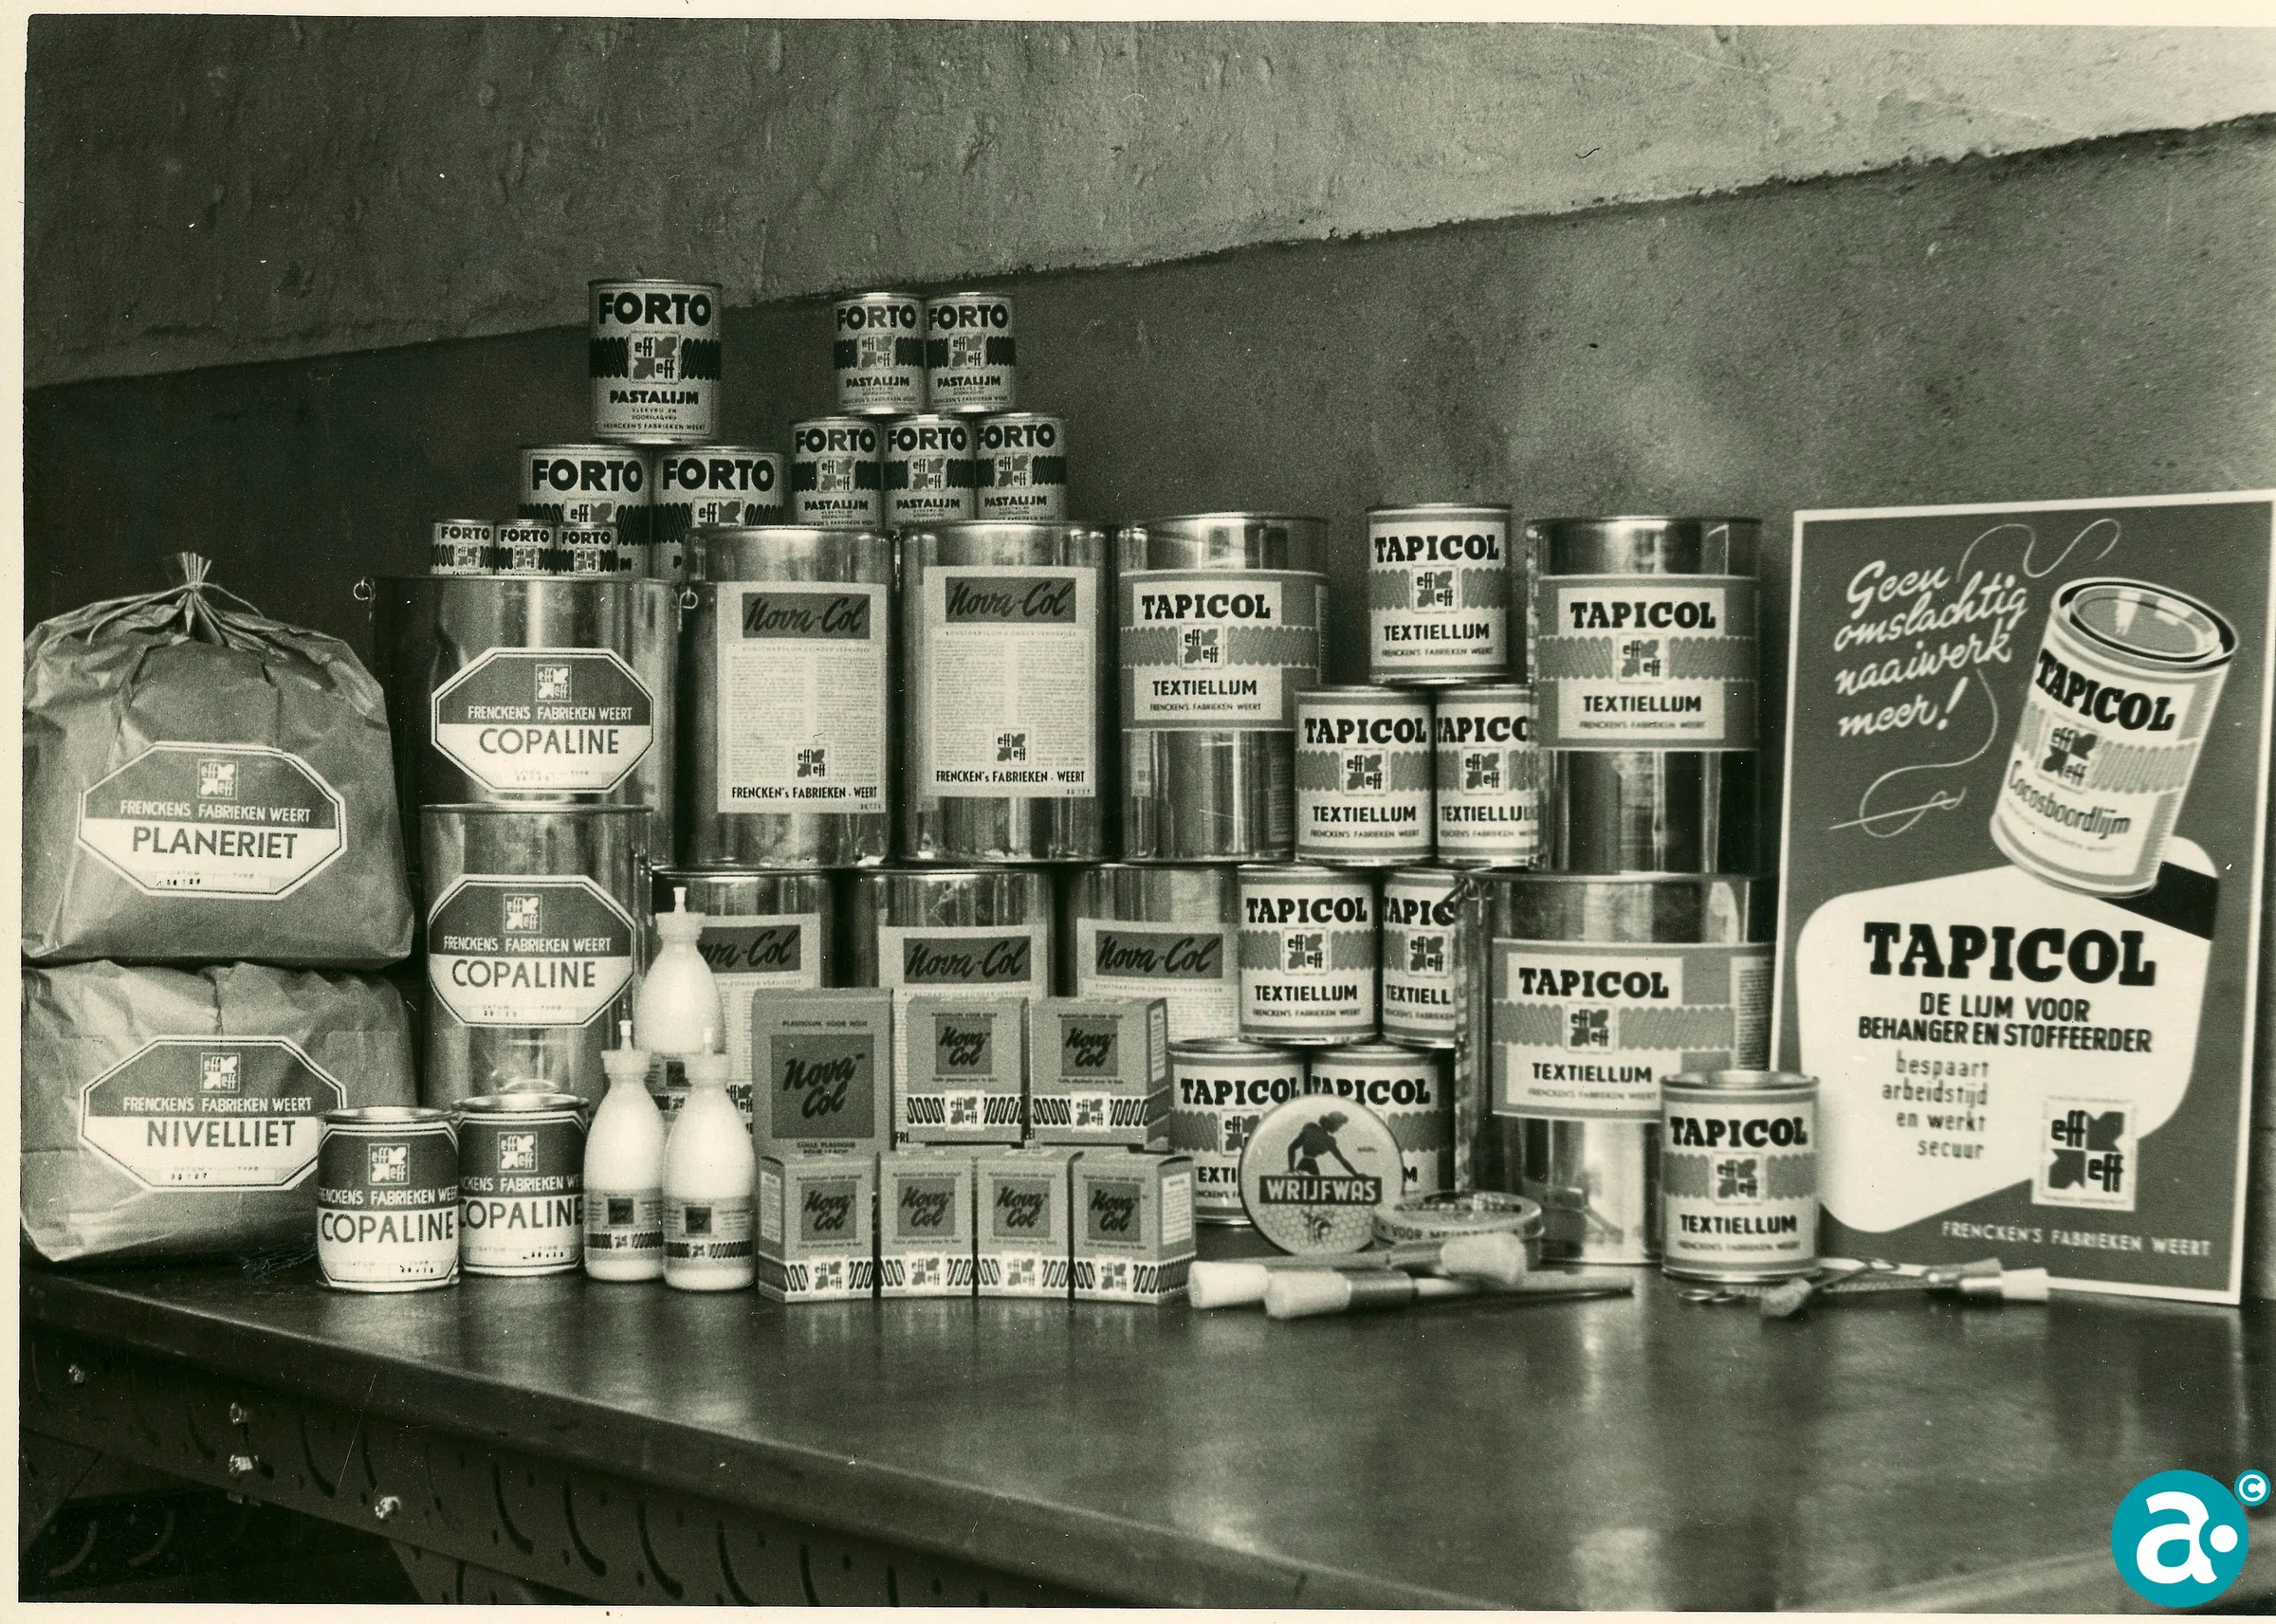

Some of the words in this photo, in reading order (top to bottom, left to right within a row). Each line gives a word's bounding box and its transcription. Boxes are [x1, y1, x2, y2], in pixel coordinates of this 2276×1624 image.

[599, 292, 711, 326] FORTO
[837, 305, 916, 331] FORTO
[928, 304, 1009, 330] FORTO
[635, 337, 652, 356] eff
[656, 359, 674, 378] eff
[846, 376, 909, 388] PASTALIJM
[938, 375, 1000, 387] PASTALIJM
[610, 391, 698, 404] PASTALIJM
[796, 429, 875, 453] FORTO
[888, 428, 967, 452] FORTO
[977, 424, 1055, 450] FORTO
[532, 459, 643, 492] FORTO
[663, 458, 774, 491] FORTO
[441, 526, 489, 540] FORTO
[501, 529, 549, 542] FORTO
[562, 532, 612, 544] FORTO
[1375, 535, 1498, 563] TAPICOL
[1417, 573, 1433, 589] eff
[1847, 560, 1949, 619] Geen
[1142, 594, 1271, 620] TAPICOL
[1436, 590, 1453, 606] eff
[1570, 602, 1716, 629] TAPICOL
[1834, 570, 2028, 651] omslachtig
[1835, 618, 2011, 695] naaiwerk
[2035, 648, 2175, 731] TAPICOL
[538, 706, 595, 720] FABRIEKEN
[599, 707, 633, 721] WEERT
[1839, 677, 1969, 737] meer!
[480, 728, 618, 754] COPALINE
[998, 734, 1010, 746] eff
[1305, 718, 1426, 743] TAPICOL
[1438, 716, 1528, 743] TAPICO
[798, 749, 811, 762] eff
[1013, 747, 1026, 760] eff
[813, 763, 825, 776] eff
[993, 771, 1048, 782] FABRIEKEN
[1057, 771, 1085, 782] WEERT
[793, 788, 846, 798] FABRIEKEN
[854, 787, 876, 798] WEERT
[199, 804, 266, 820] FABRIEKEN
[270, 808, 310, 822] WEERT
[133, 826, 297, 858] PLANERIET
[1246, 898, 1367, 923] TAPICOL
[505, 938, 569, 952] FABRIEKEN
[573, 938, 611, 951] WEERT
[1863, 921, 2157, 987] TAPICOL
[452, 959, 596, 988] COPALINE
[1519, 967, 1669, 998] TAPICOL
[1919, 993, 1950, 1015] DE
[2025, 997, 2090, 1022] VOOR
[1859, 1016, 1969, 1044] BEHANGER
[1973, 1024, 1999, 1045] EN
[2004, 1024, 2152, 1052] STOFFEERDER
[949, 1045, 982, 1067] Col
[1074, 1046, 1109, 1067] Col
[1897, 1050, 1990, 1079] bespaart
[802, 1081, 848, 1119] Col
[1181, 1077, 1300, 1105] TAPICOL
[1312, 1075, 1430, 1105] TAPICOL
[1881, 1079, 1989, 1107] arbeidstijd
[202, 1098, 267, 1112] FABRIEKEN
[272, 1098, 312, 1111] WEERT
[147, 1121, 296, 1147] NIVELLIET
[1670, 1117, 1808, 1147] TAPICOL
[1897, 1112, 1918, 1127] en
[1927, 1113, 1986, 1132] werkt
[2051, 1110, 2085, 1147] eff
[1918, 1140, 1984, 1159] secuur
[501, 1177, 563, 1192] FABRIEKEN
[2087, 1154, 2122, 1193] eff
[371, 1189, 433, 1204] FABRIEKEN
[1267, 1179, 1375, 1200] WRIJFWAS
[321, 1211, 453, 1243] COPALINE
[814, 1210, 849, 1232] Col
[910, 1207, 945, 1228] Col
[1006, 1207, 1039, 1228] Col
[1099, 1209, 1131, 1232] Col
[2051, 1232, 2141, 1251] FABRIEKEN
[2152, 1238, 2212, 1256] WEERT
